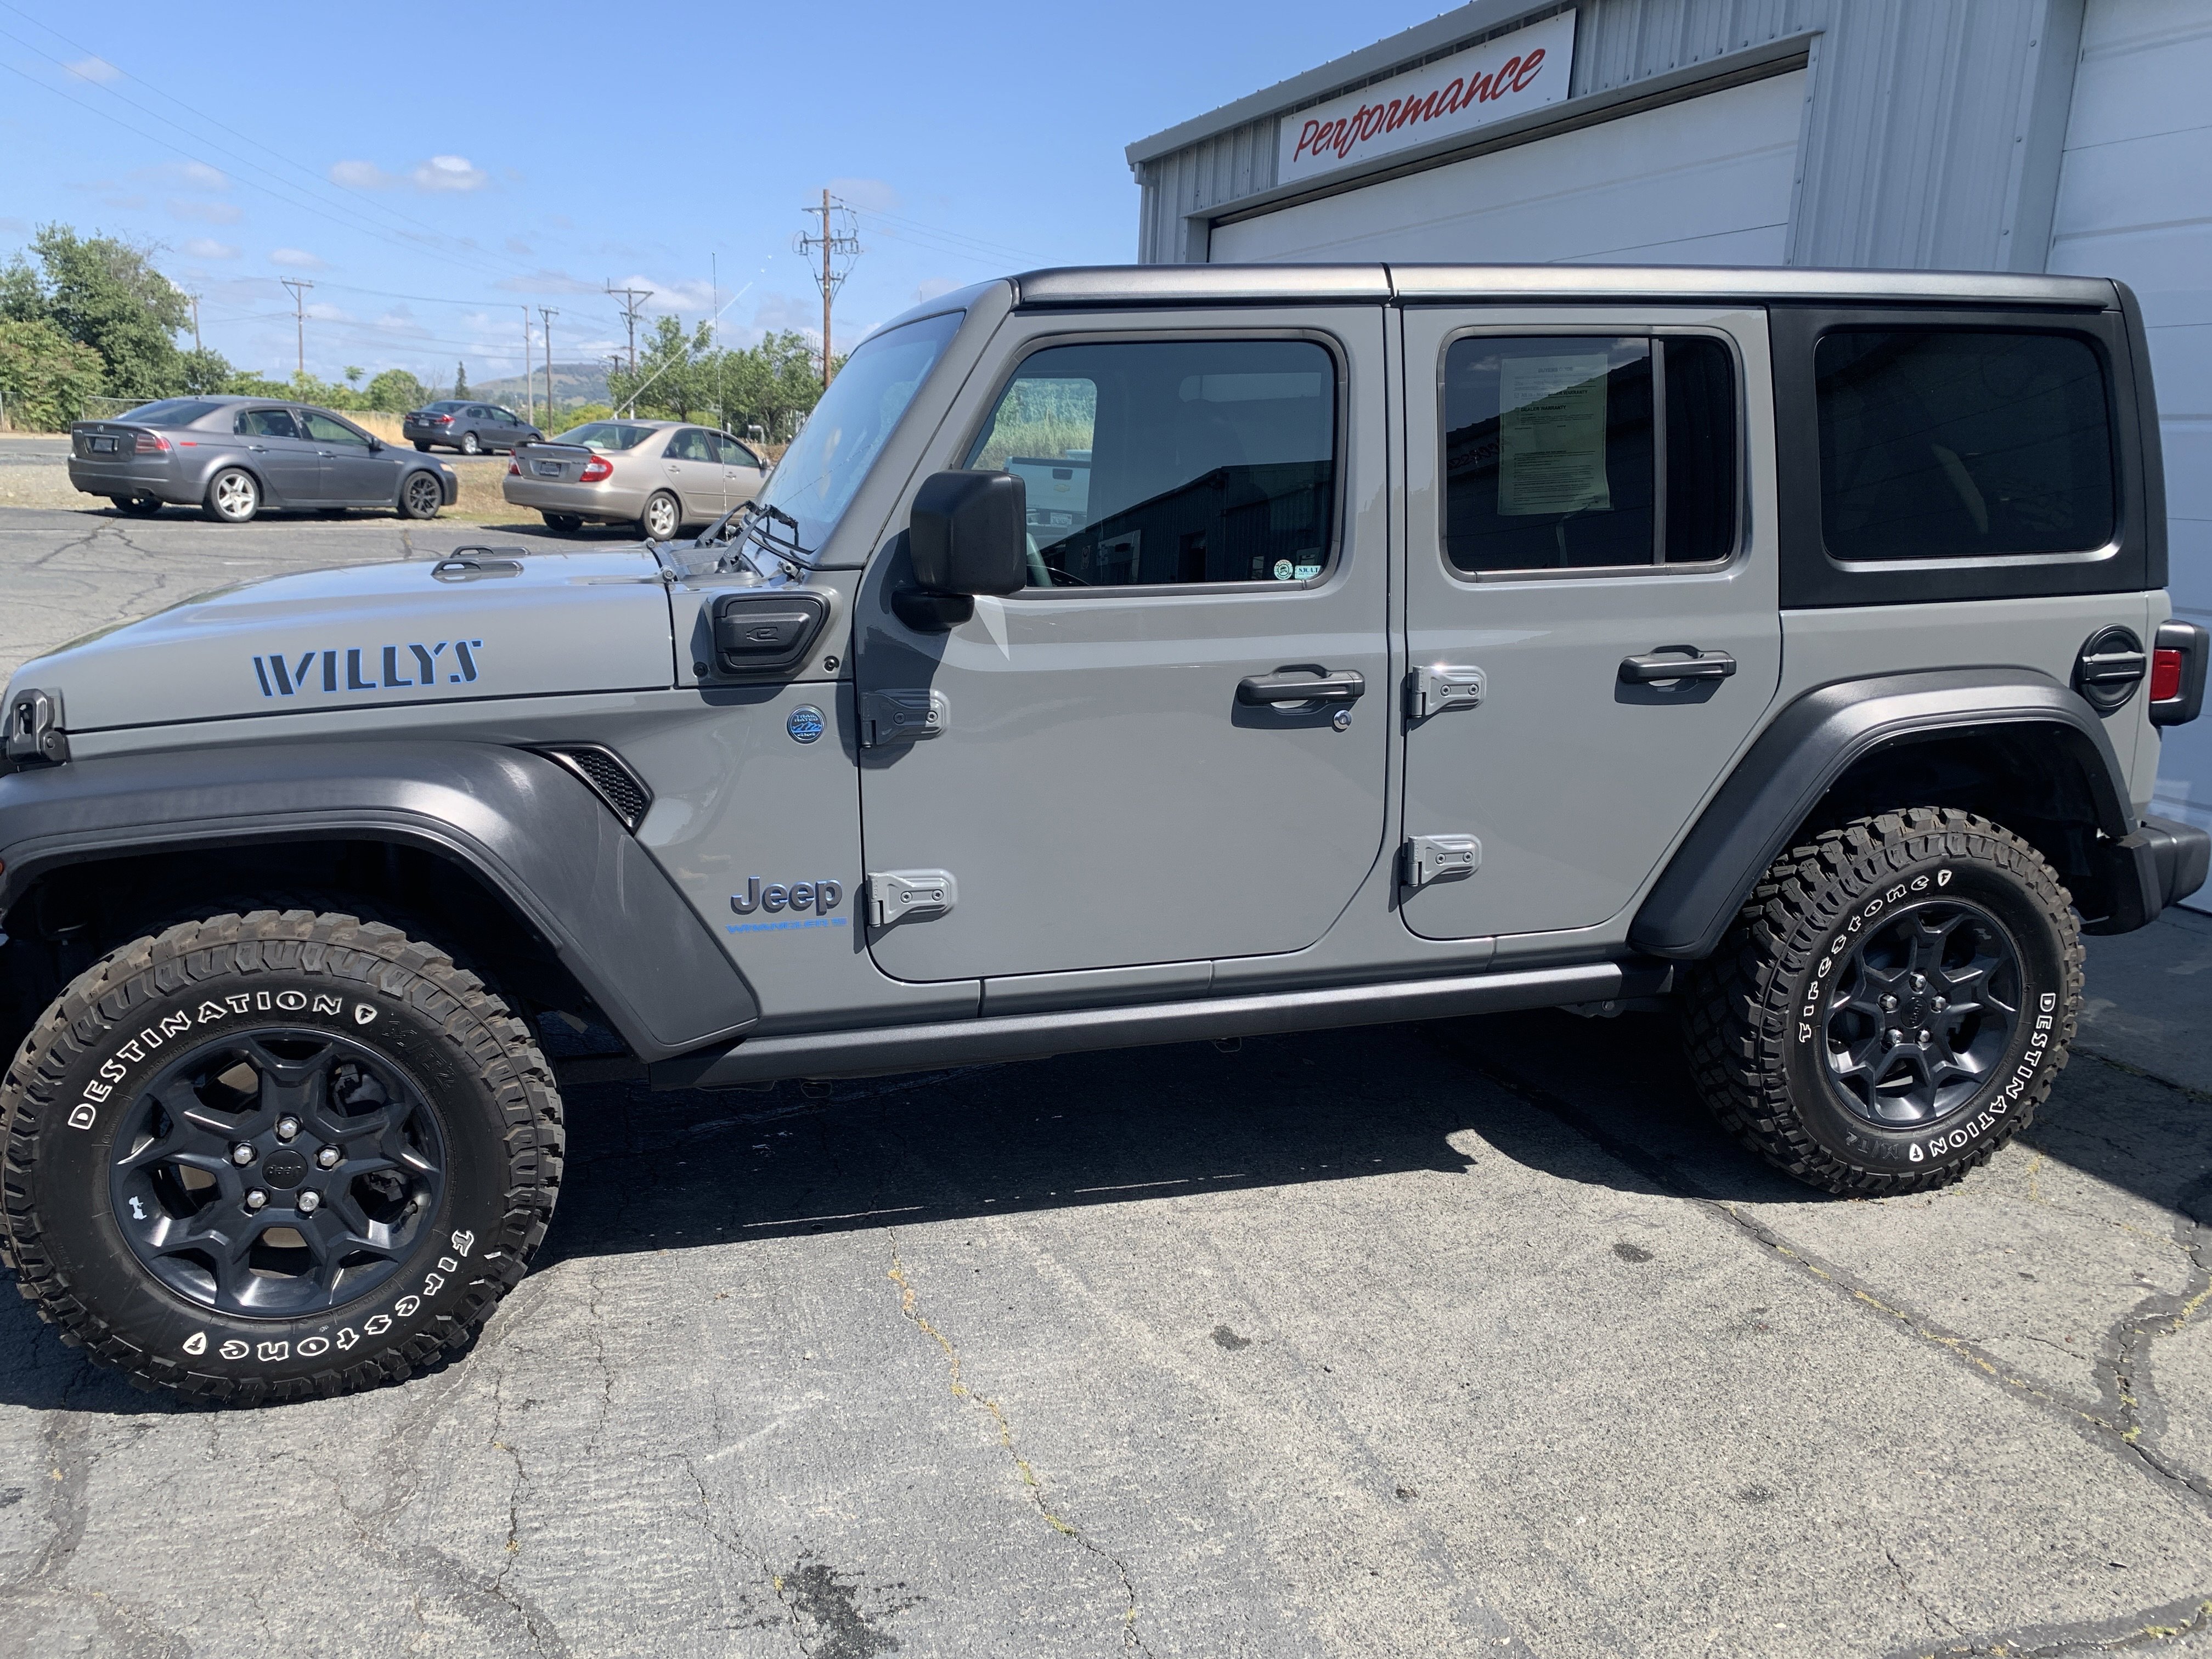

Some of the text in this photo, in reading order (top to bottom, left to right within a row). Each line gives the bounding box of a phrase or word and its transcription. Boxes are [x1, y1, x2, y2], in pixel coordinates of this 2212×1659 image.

[1292, 48, 1546, 162] Performance
[253, 639, 483, 697] WILLYS
[731, 876, 843, 916] Jeep
[1798, 875, 1929, 1043] Firestone
[67, 990, 342, 1131] DESTINATION
[1929, 992, 2056, 1157] DESTINATION
[219, 1229, 474, 1362] Firestone
